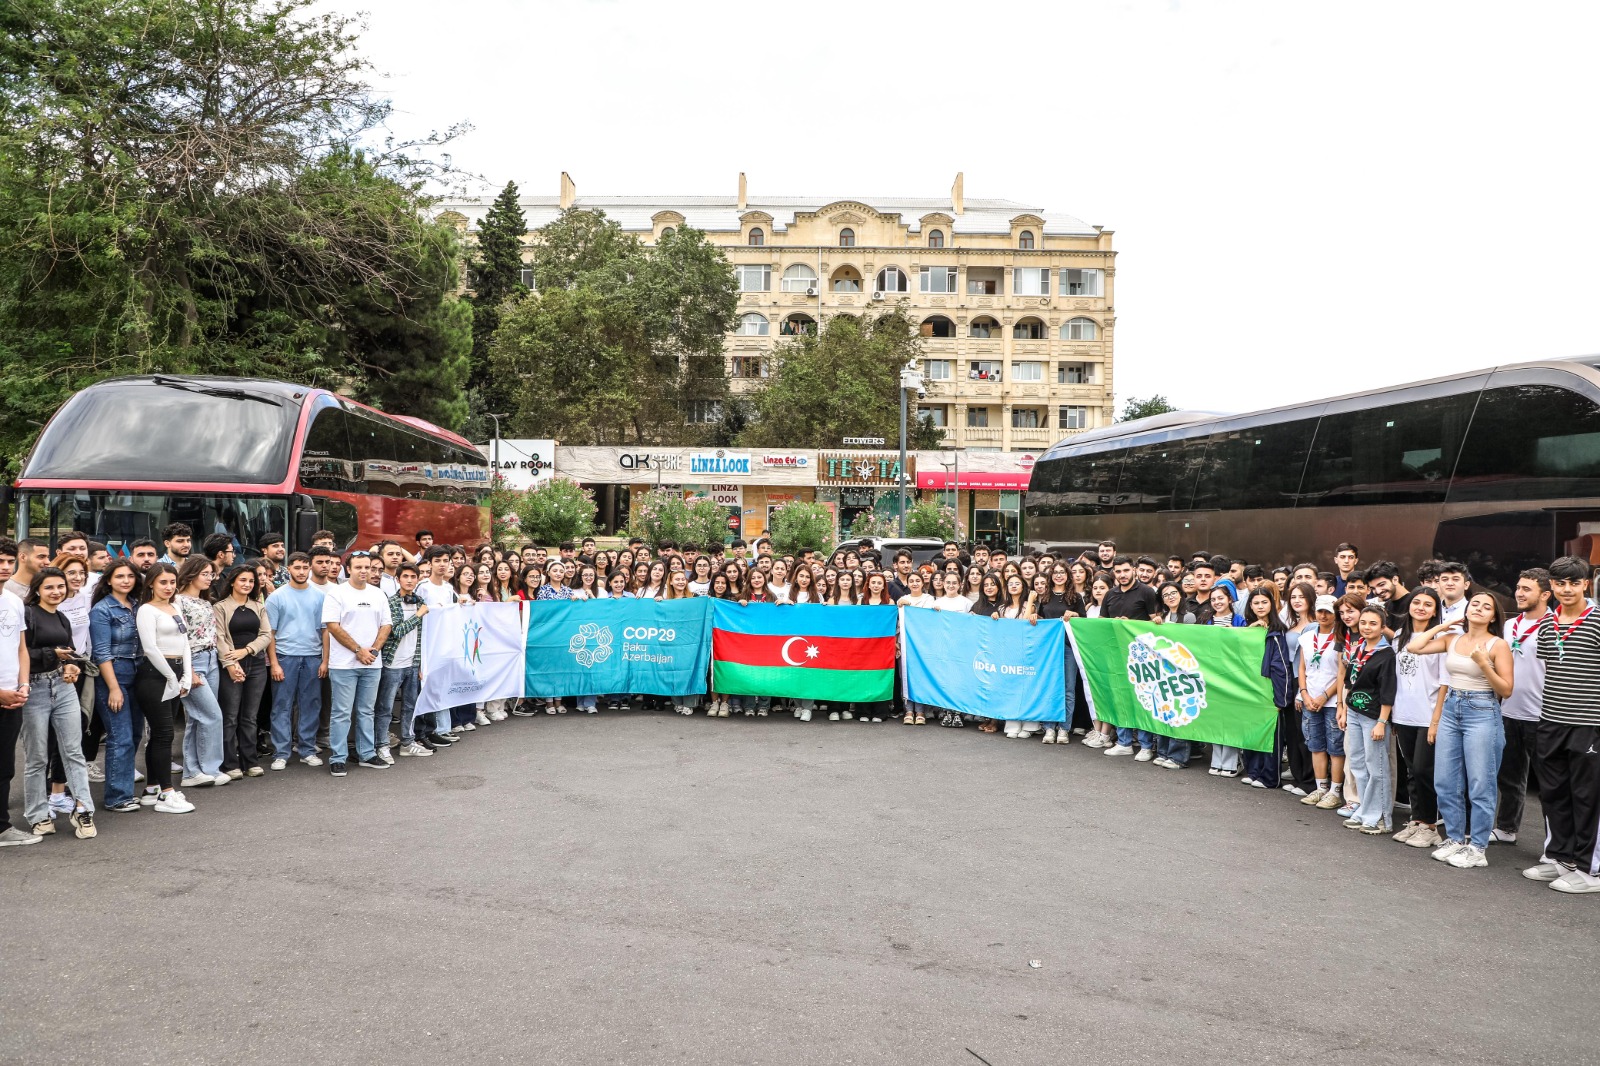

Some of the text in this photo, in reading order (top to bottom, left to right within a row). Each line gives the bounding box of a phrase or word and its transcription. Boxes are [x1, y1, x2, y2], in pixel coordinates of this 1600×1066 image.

[520, 461, 552, 469] ROOM
[723, 458, 749, 473] LOOK
[763, 455, 797, 464] Linza Evi
[623, 626, 676, 641] COP29
[622, 642, 647, 652] Baku
[622, 652, 673, 664] Azerbaijan
[975, 661, 997, 672] IDEA
[1001, 665, 1023, 675] ONE
[1129, 660, 1161, 683] YAY
[1158, 673, 1204, 701] FEST
